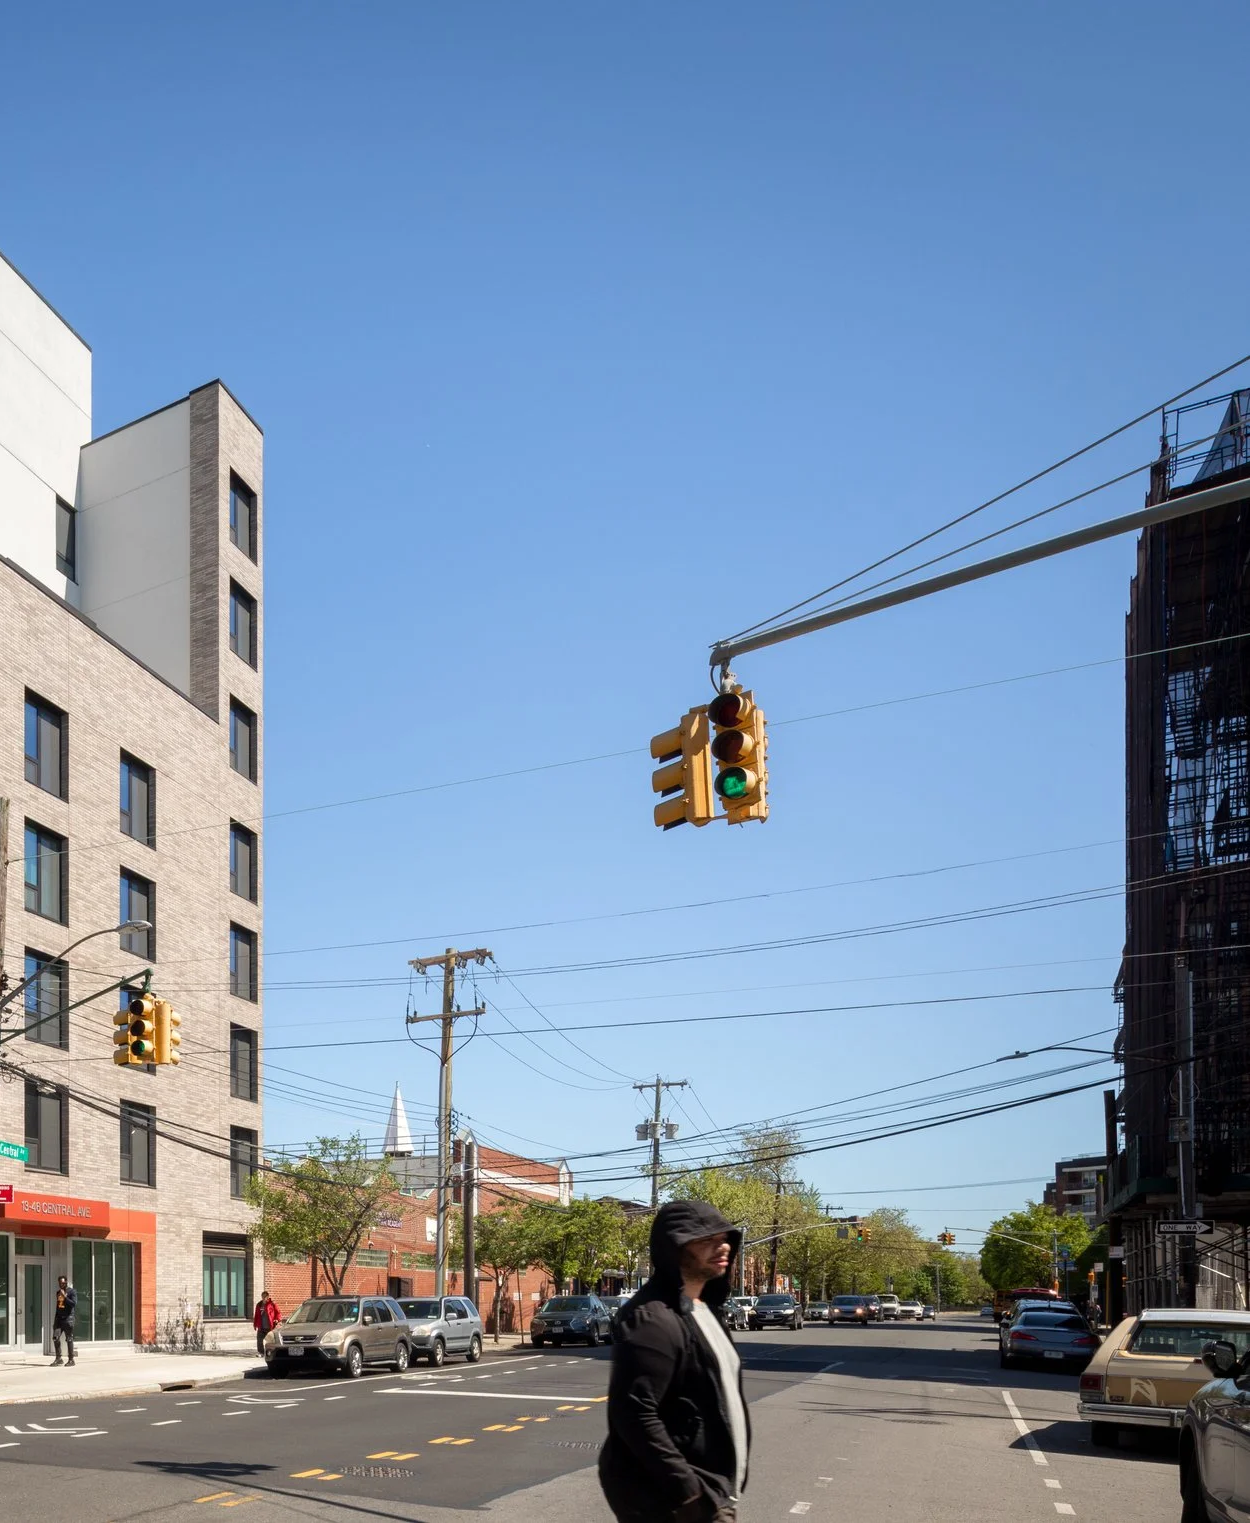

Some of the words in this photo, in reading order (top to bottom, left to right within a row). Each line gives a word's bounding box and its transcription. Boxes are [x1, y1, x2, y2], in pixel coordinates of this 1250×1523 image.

[0, 1142, 19, 1157] Central
[21, 1200, 41, 1213] 13-46
[42, 1202, 76, 1217] CENTRAL
